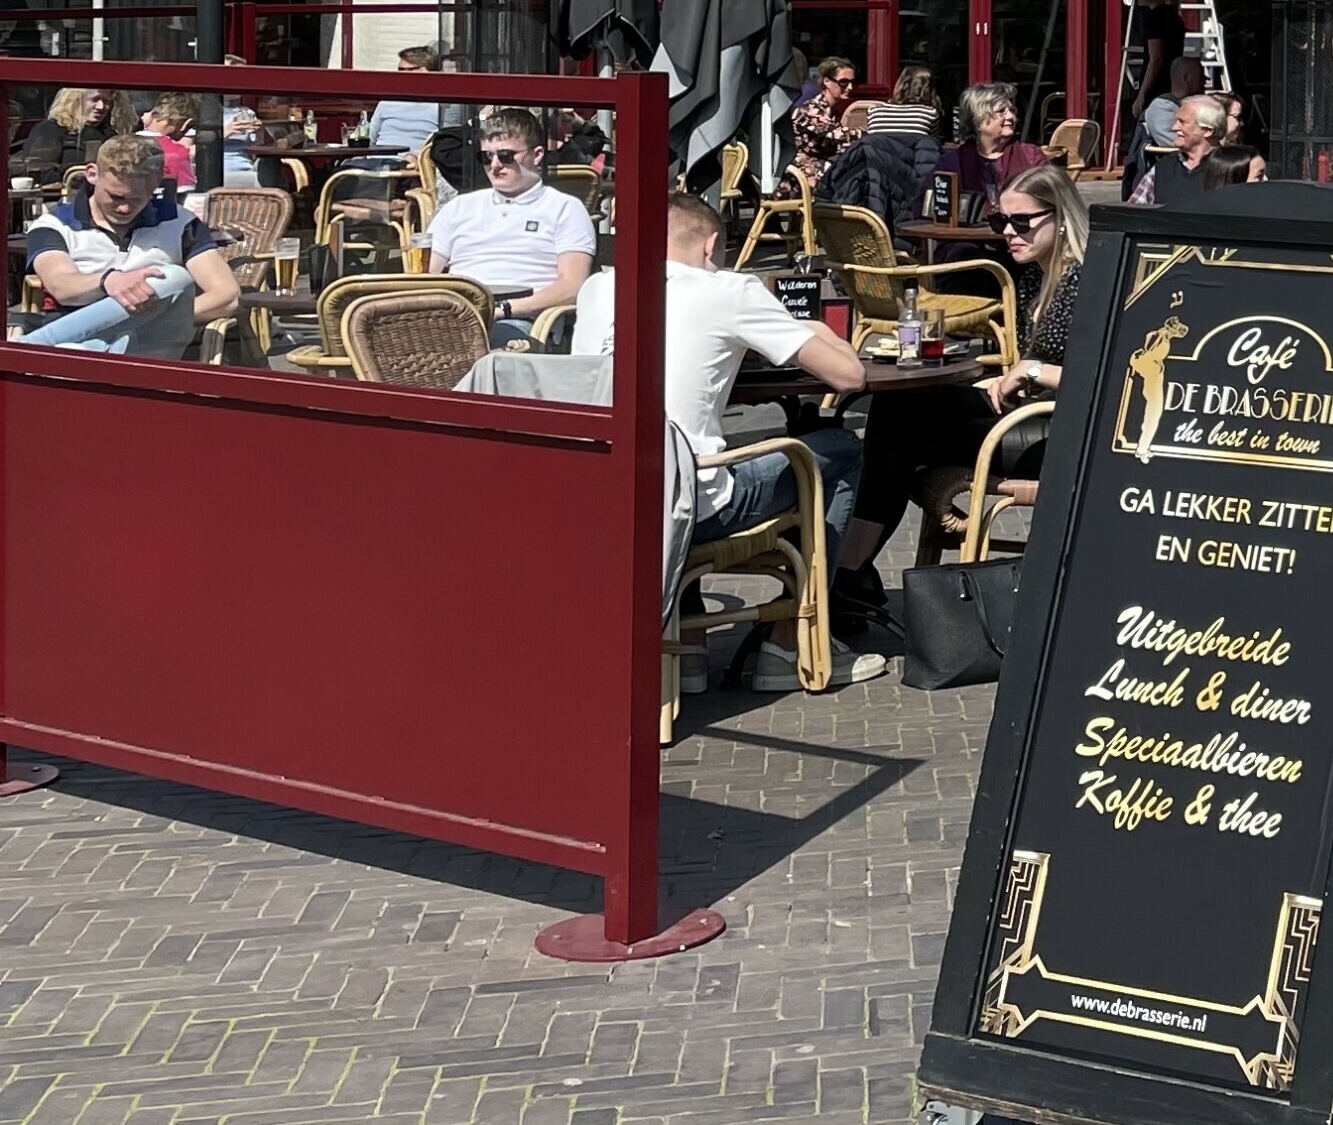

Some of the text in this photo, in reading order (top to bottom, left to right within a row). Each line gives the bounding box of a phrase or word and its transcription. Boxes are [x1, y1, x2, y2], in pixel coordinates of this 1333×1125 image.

[1227, 327, 1298, 384] Café
[1165, 381, 1198, 413] DE
[1174, 420, 1321, 454] the best in town
[1119, 487, 1155, 516] GA
[1163, 490, 1251, 524] LEKKER
[1156, 535, 1297, 576] EN GENIET!
[1116, 605, 1291, 667] Uitgebreide
[1086, 660, 1311, 725] Lunch & diner
[1076, 718, 1303, 784] Speciaalbieren
[1076, 770, 1282, 838] Koffie & thee
[1071, 993, 1207, 1032] www.debrasserie.nl
